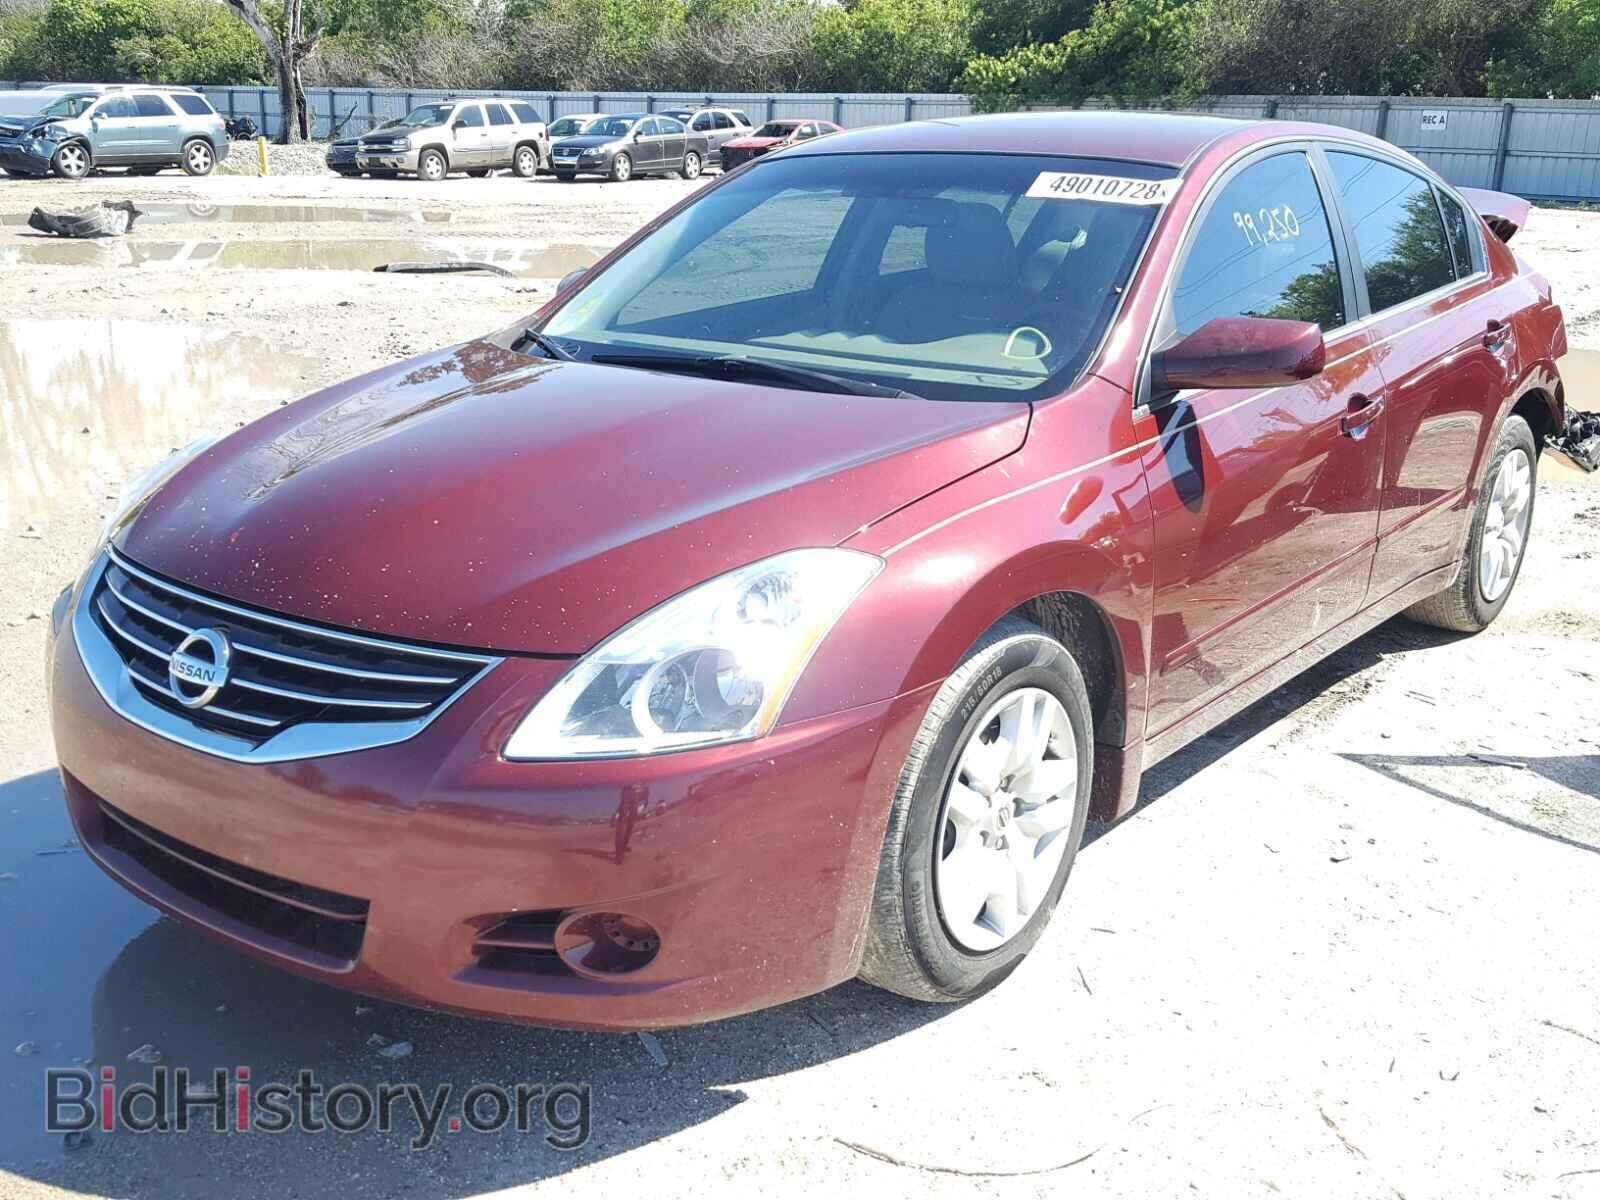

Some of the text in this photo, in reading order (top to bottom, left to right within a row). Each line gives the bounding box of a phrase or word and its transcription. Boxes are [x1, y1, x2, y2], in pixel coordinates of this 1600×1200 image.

[1422, 115, 1445, 125] REC A
[1050, 175, 1162, 200] 49010728
[170, 656, 216, 682] NISSAN
